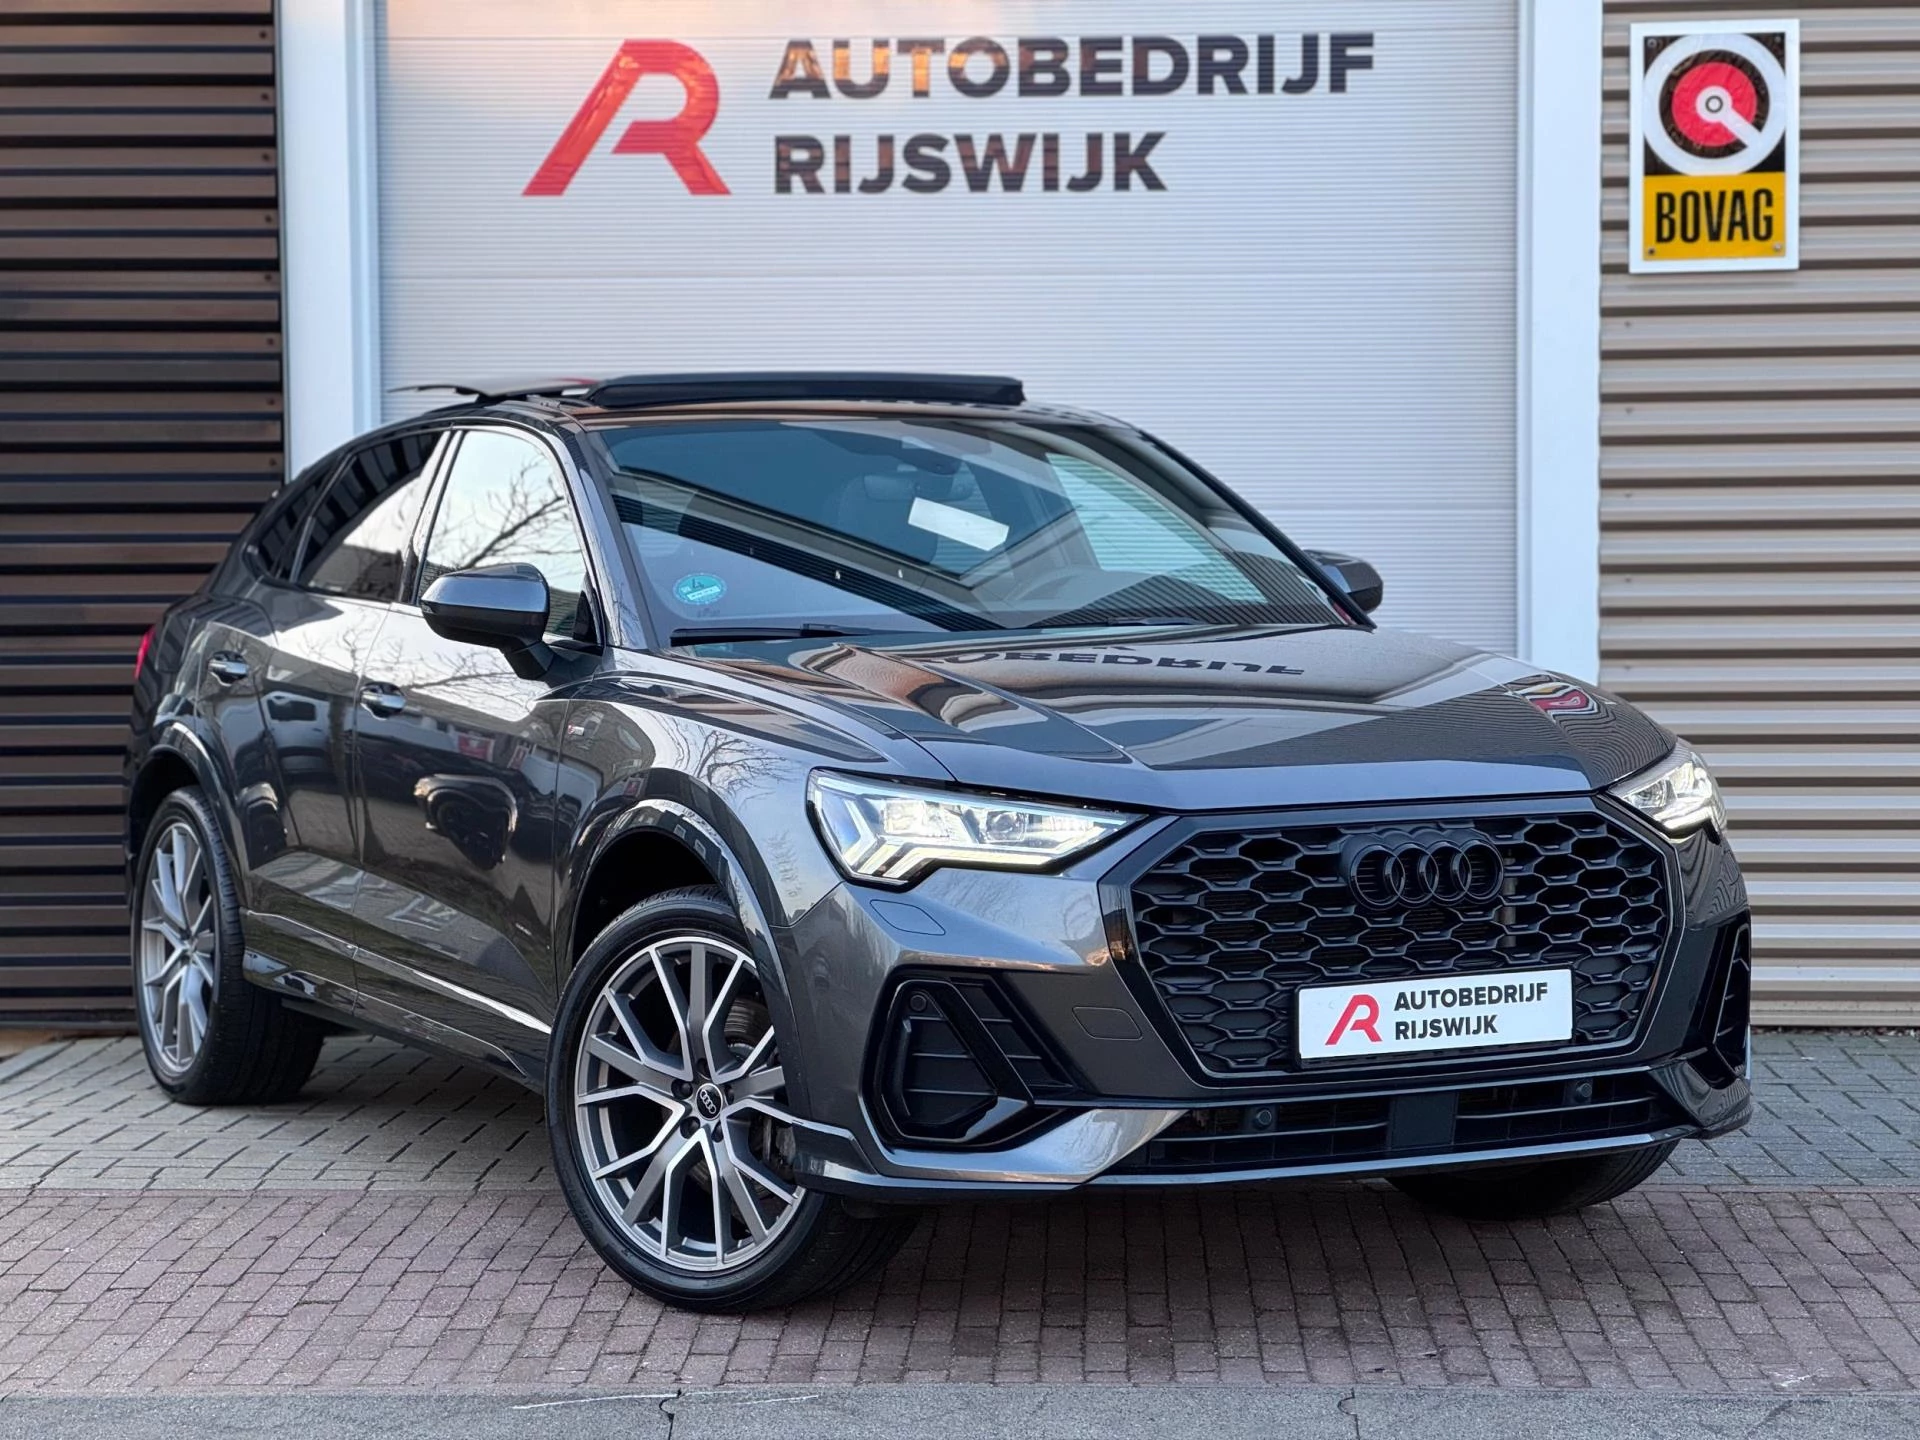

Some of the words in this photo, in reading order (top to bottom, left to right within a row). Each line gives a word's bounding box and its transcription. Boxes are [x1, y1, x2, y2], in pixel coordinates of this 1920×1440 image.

[768, 32, 1375, 100] AUTOBEDRIJF
[774, 132, 1168, 194] RIJSWIJK
[1655, 188, 1774, 244] BOVAG
[1393, 982, 1548, 1011] AUTOBEDRIJF
[1394, 1014, 1499, 1041] RIJSWIJK
